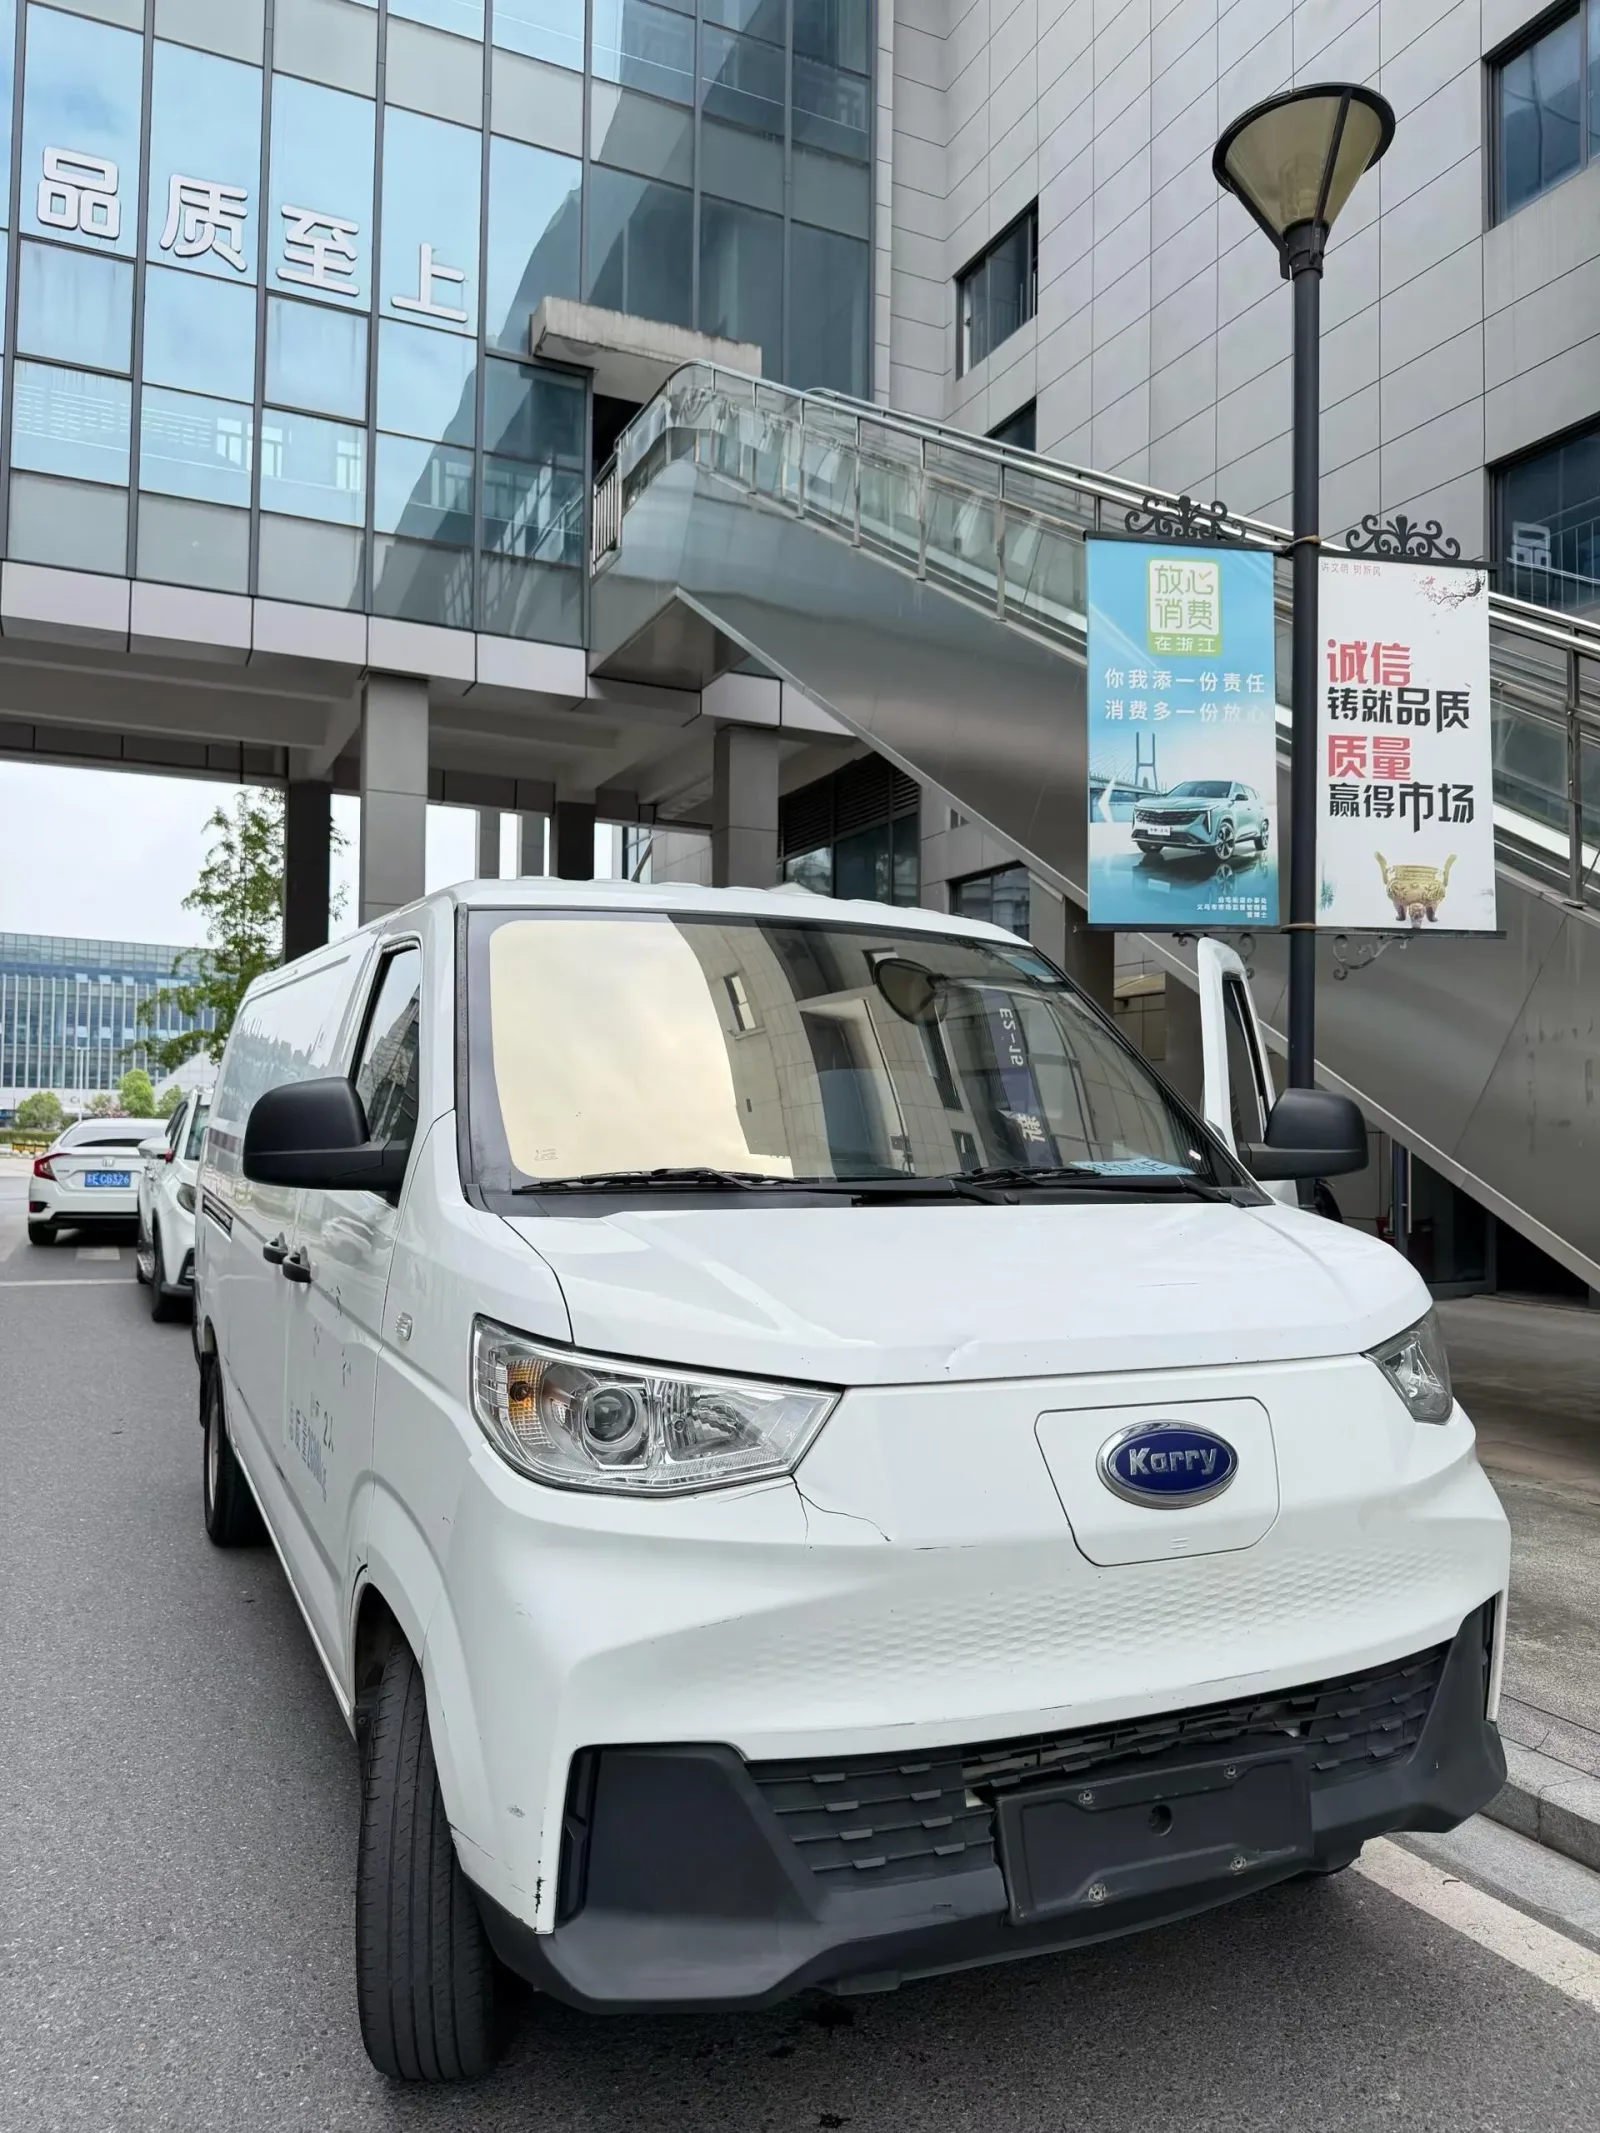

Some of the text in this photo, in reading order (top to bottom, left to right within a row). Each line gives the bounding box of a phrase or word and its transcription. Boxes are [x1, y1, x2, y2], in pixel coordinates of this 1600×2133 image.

[37, 146, 468, 323] 品质至上
[1154, 565, 1214, 596] 放心
[1155, 597, 1213, 630] 消费
[1154, 636, 1216, 653] 在浙江
[1327, 639, 1411, 687] 诚信
[1105, 668, 1265, 693] 你我添一份责任
[1105, 699, 1265, 724] 消费多一份放心
[1327, 686, 1470, 733] 铸就品质
[1328, 735, 1411, 781] 质量
[1328, 781, 1475, 833] 赢得市场
[1129, 1448, 1218, 1475] Karry
